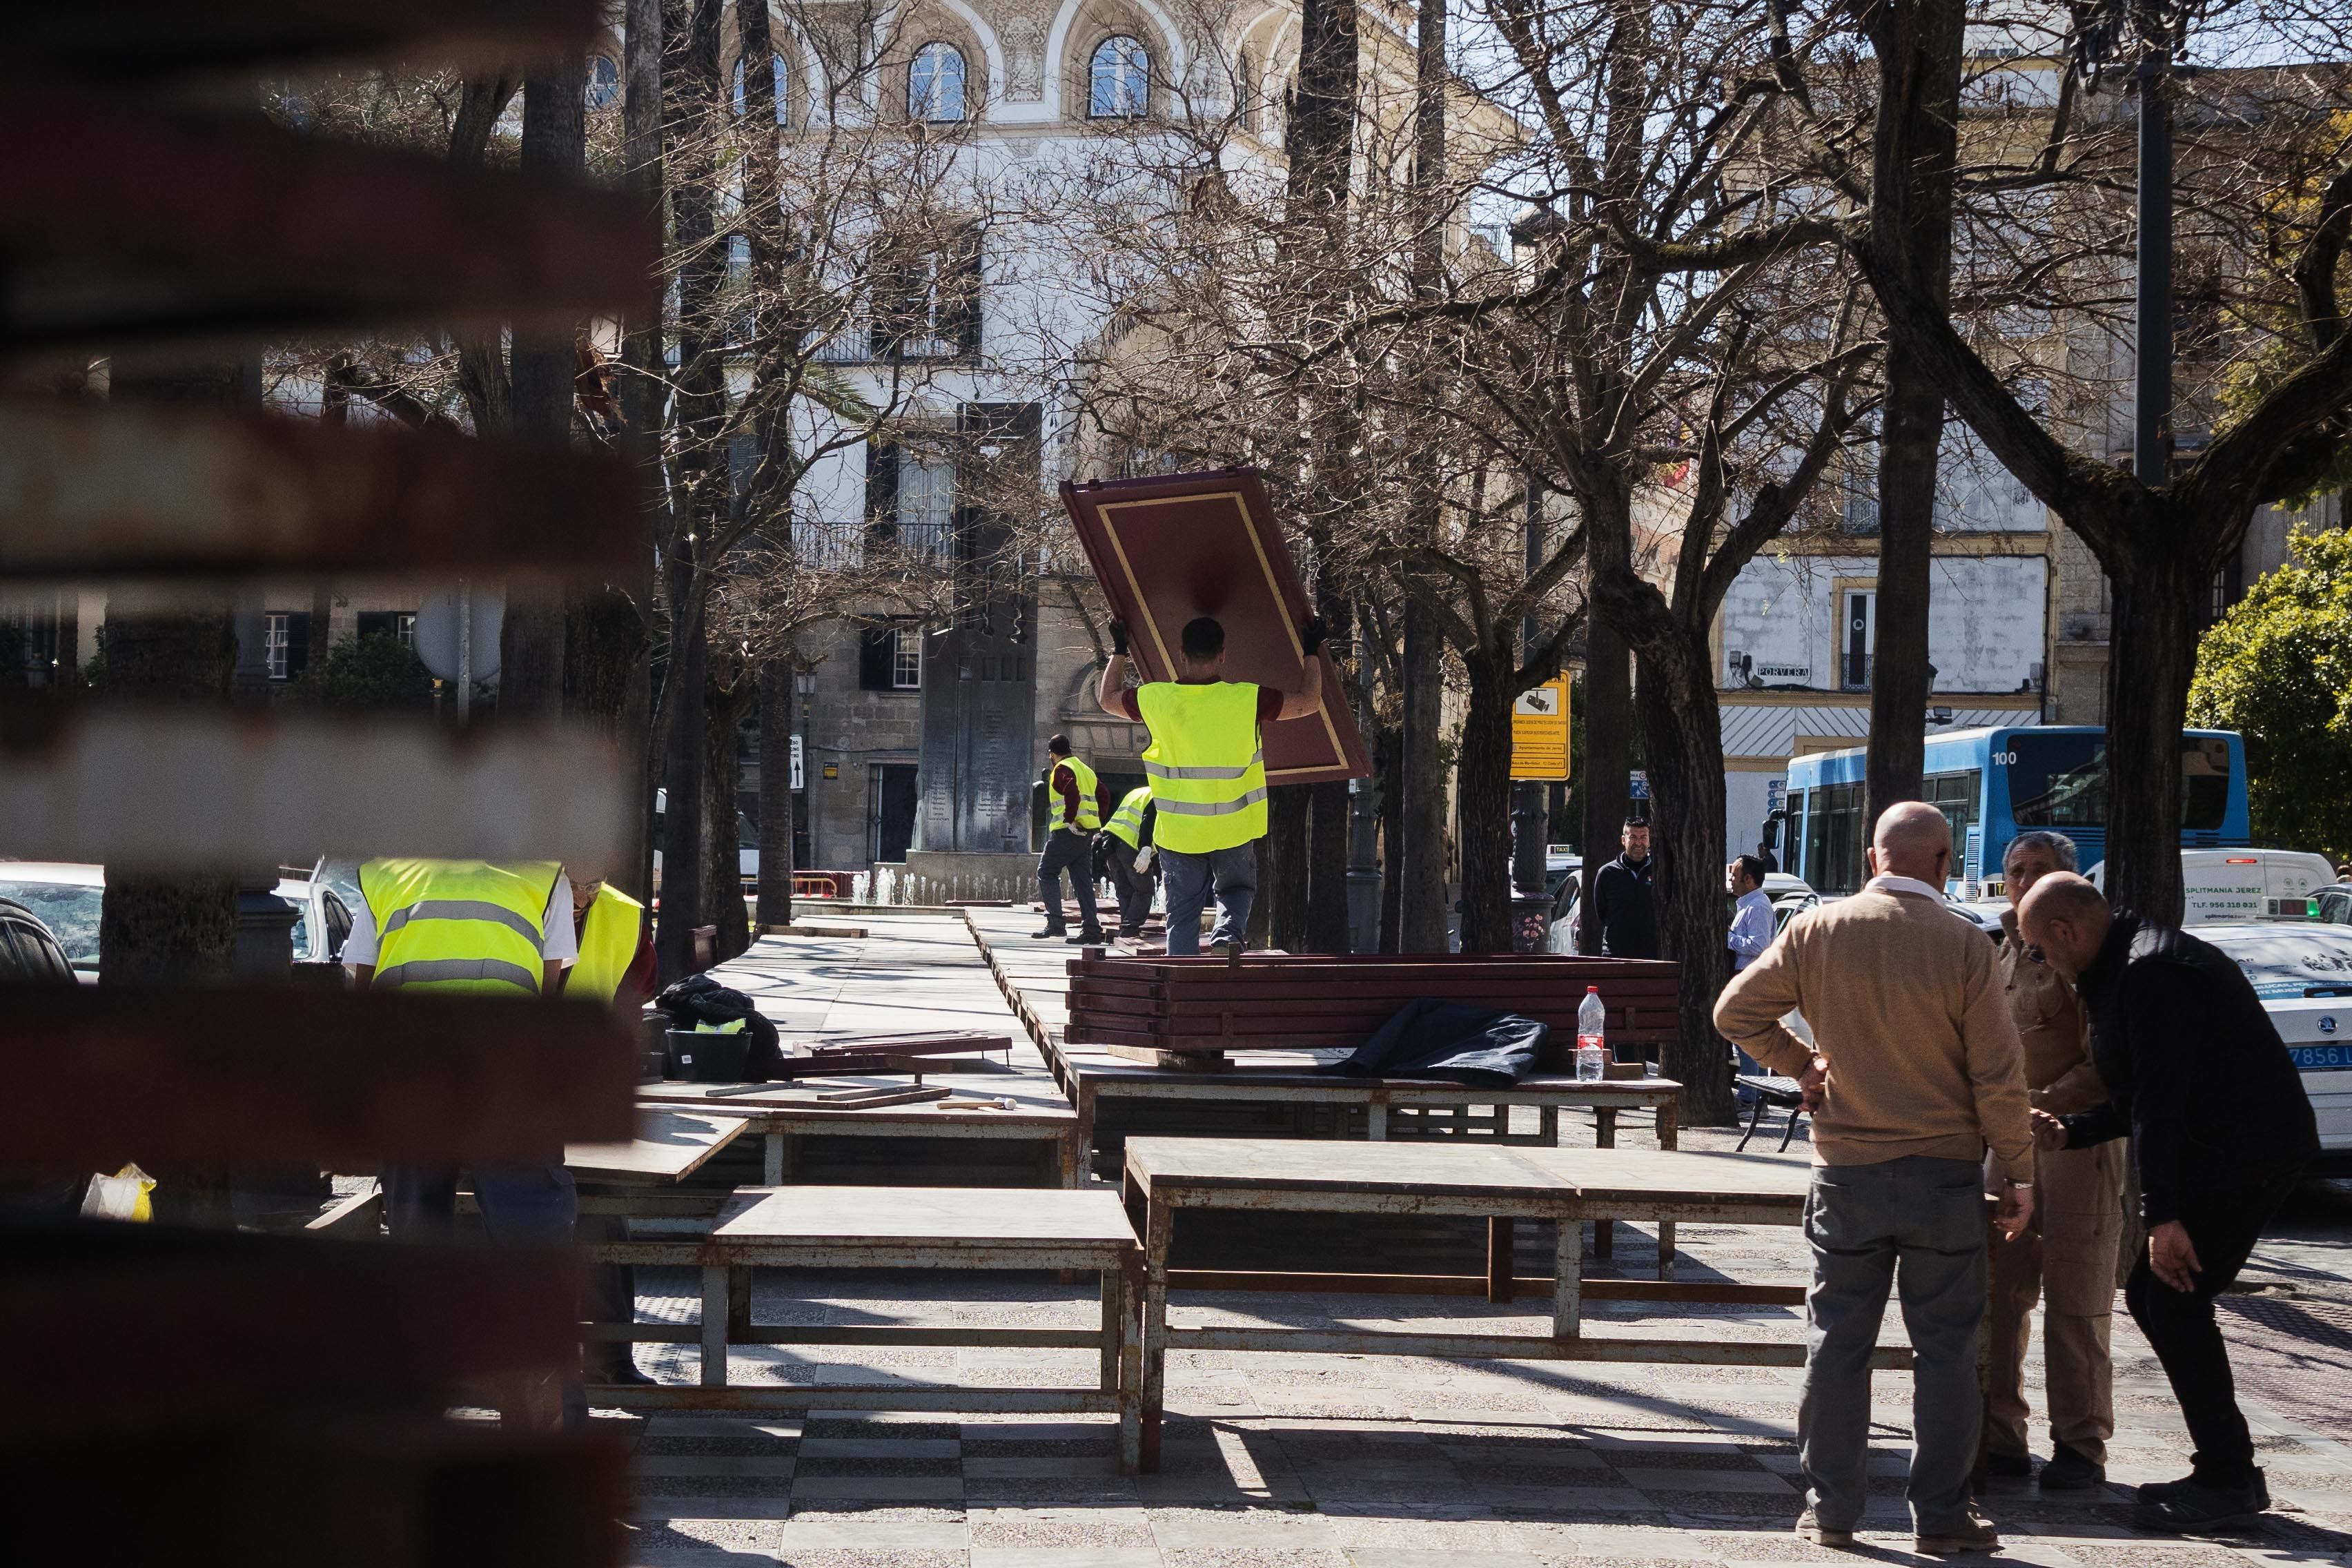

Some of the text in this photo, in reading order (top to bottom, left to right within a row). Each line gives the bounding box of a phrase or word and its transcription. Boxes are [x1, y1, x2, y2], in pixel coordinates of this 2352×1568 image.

[1758, 667, 1808, 676] PORVERA
[1992, 752, 2017, 765] 100
[2289, 1048, 2339, 1064] 7856
